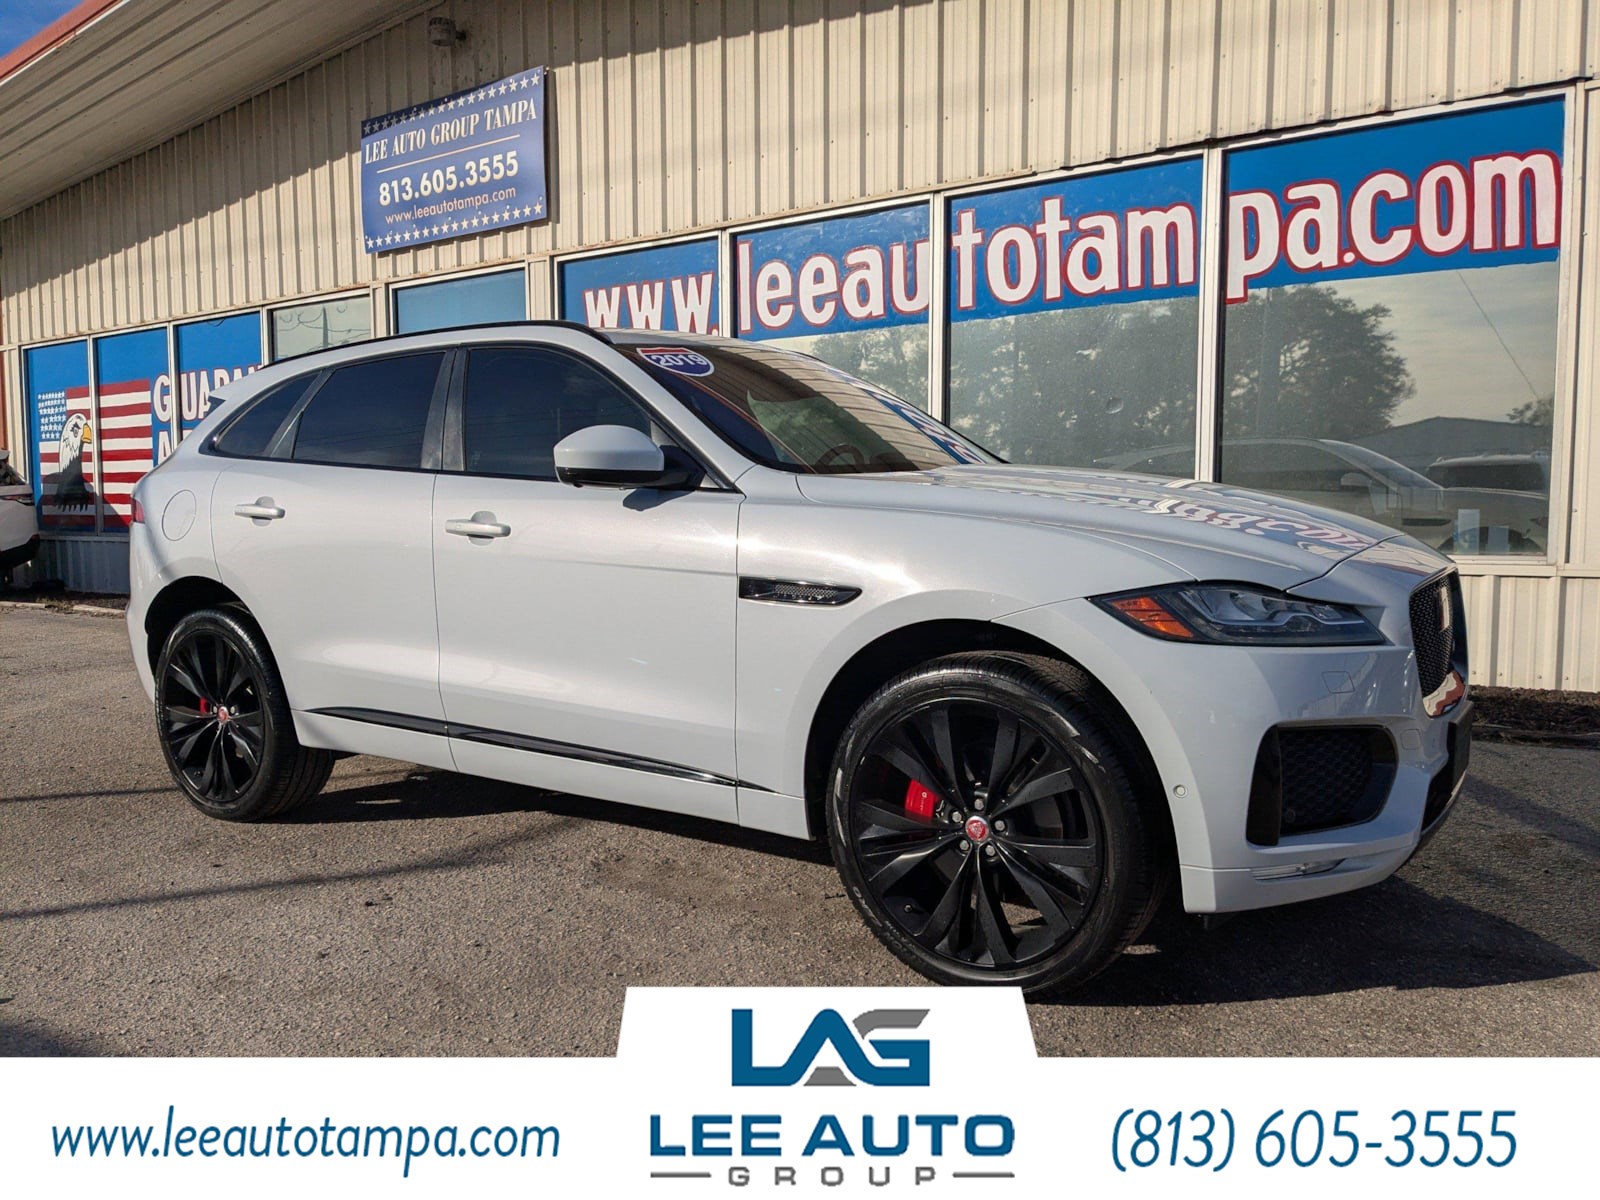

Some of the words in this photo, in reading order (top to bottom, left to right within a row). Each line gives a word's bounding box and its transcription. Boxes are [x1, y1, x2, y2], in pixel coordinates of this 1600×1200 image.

[364, 138, 388, 165] LEE
[391, 128, 426, 157] AUTO
[430, 113, 480, 146] GROUP
[484, 97, 537, 132] TAMPA
[379, 150, 519, 207] 813.605.3555
[385, 186, 516, 225] www.leeautotampa.com
[650, 353, 708, 367] 2019
